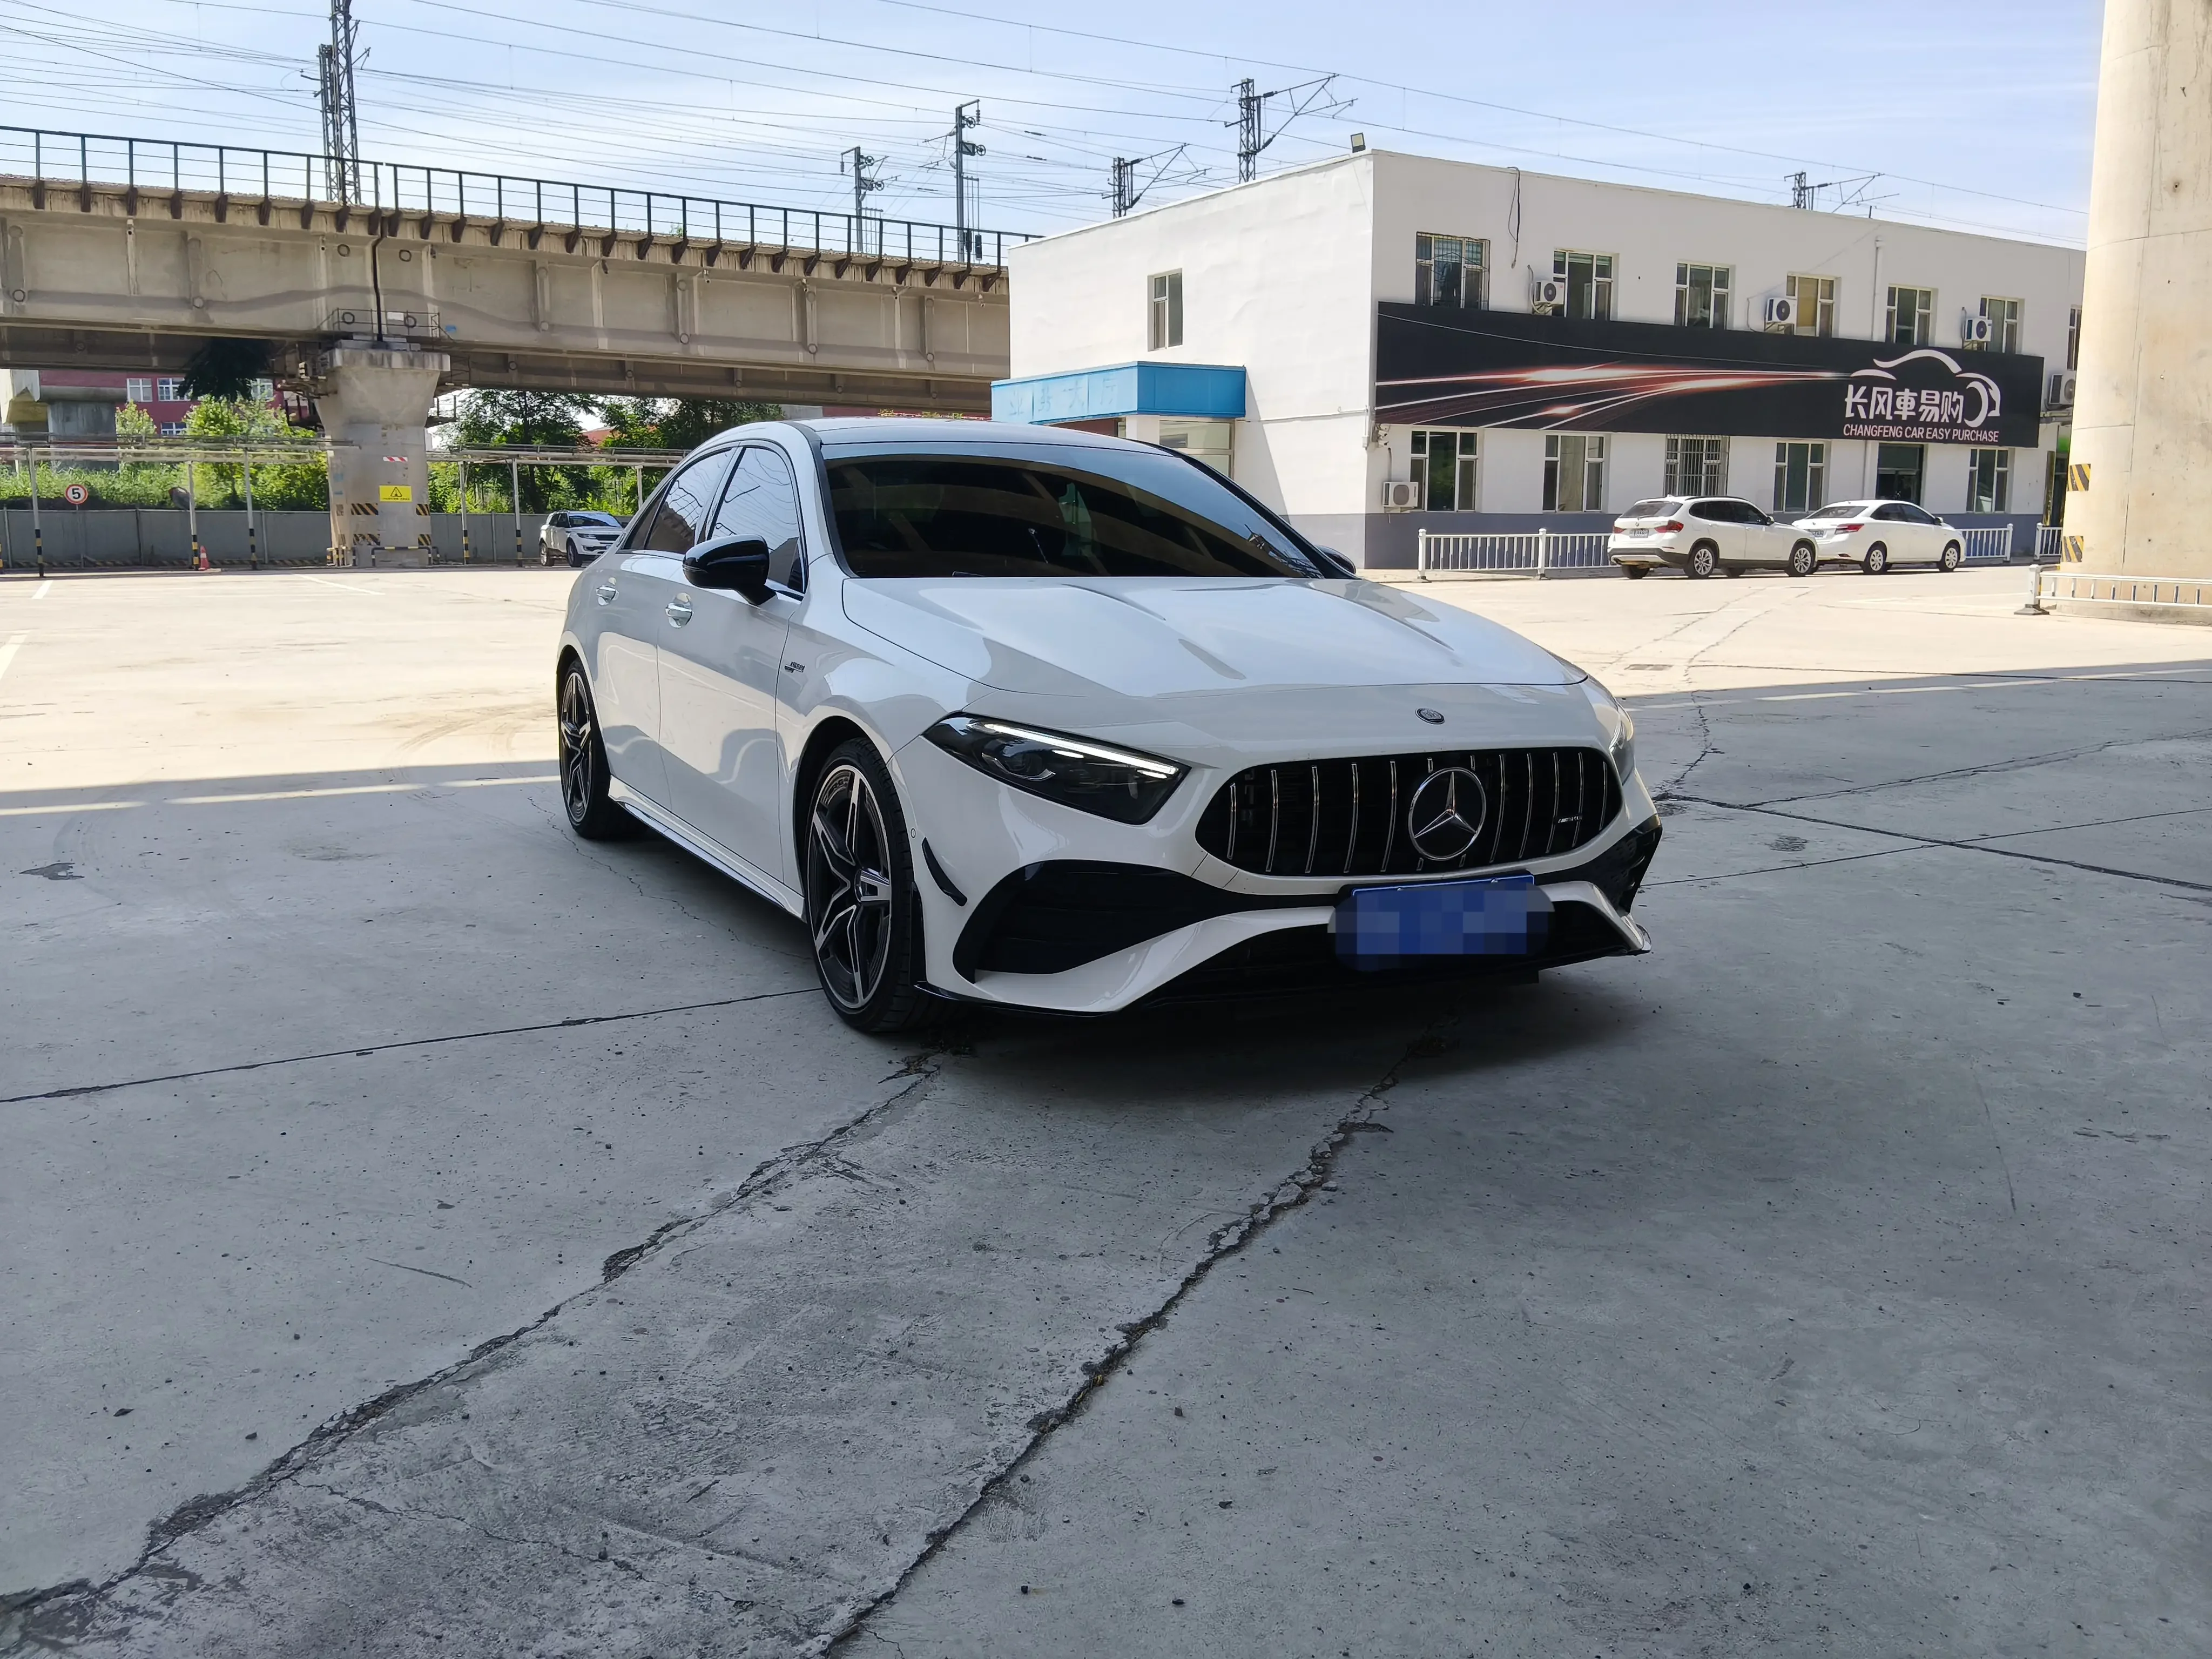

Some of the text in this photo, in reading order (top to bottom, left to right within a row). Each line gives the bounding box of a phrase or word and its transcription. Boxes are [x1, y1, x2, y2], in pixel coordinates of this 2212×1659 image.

[1843, 423, 2000, 442] CHANGFENG CAR EASY PURCHASE
[72, 488, 81, 500] 5
